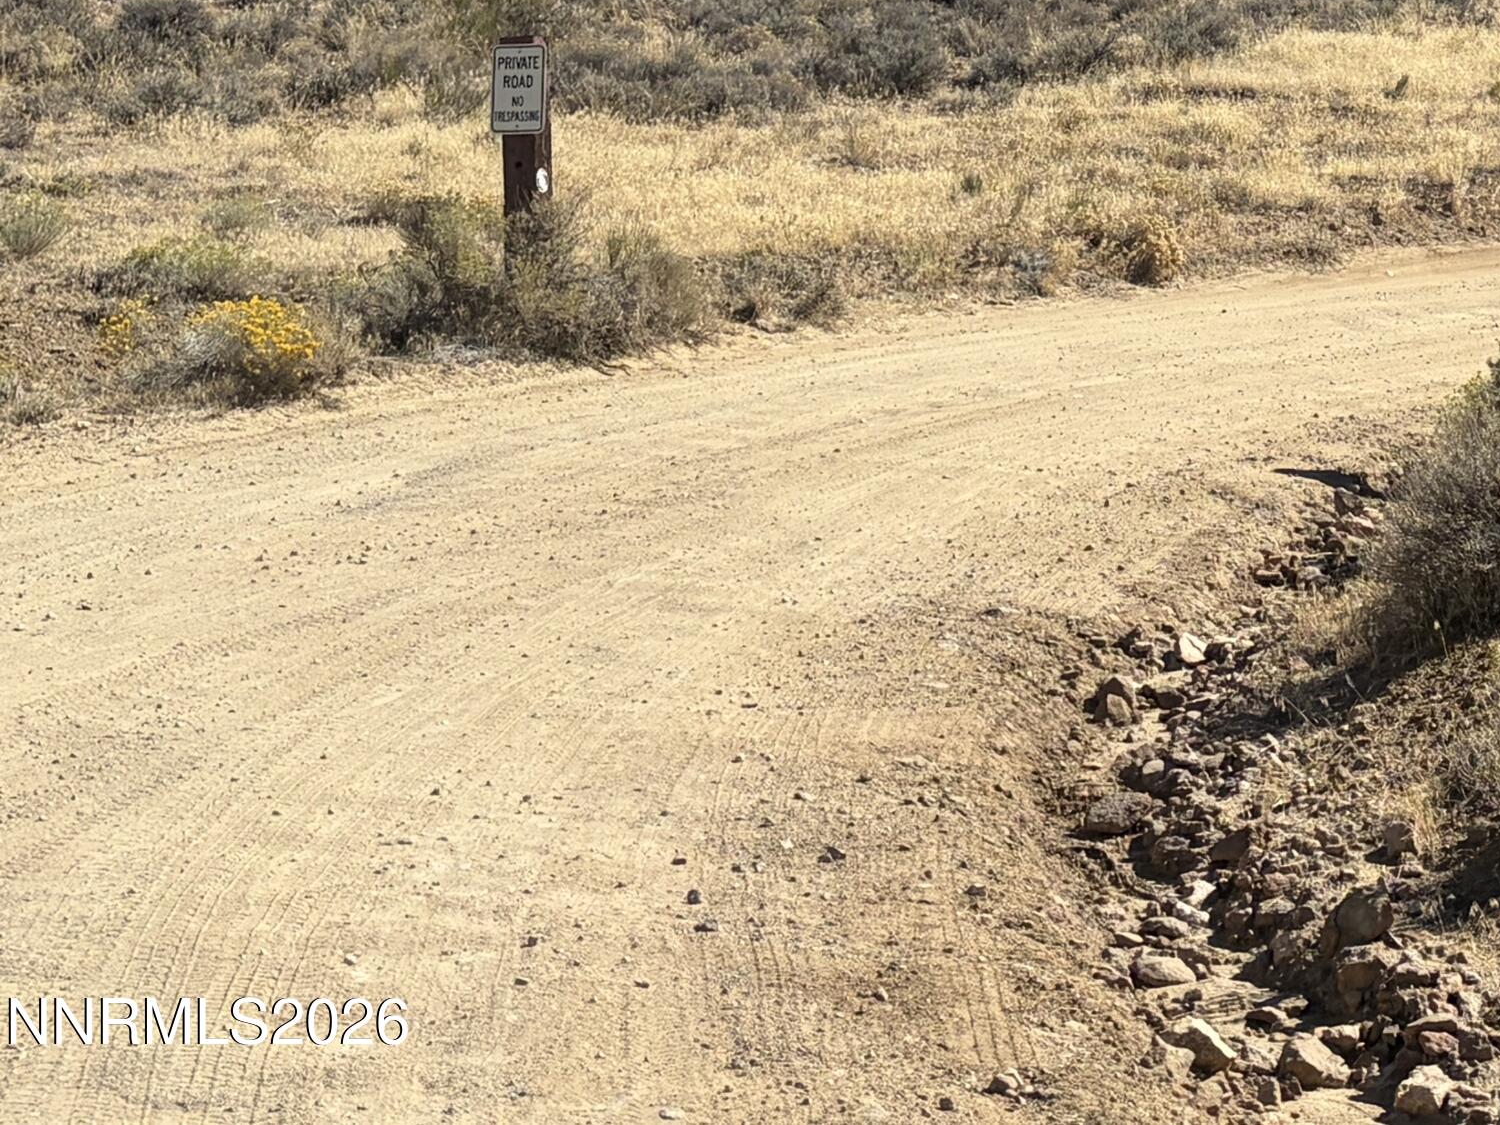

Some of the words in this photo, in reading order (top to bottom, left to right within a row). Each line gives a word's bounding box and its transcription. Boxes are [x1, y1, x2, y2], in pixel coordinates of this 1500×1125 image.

[497, 56, 540, 70] PRIVATE
[503, 75, 533, 88] ROAD
[511, 96, 524, 107] NO
[494, 110, 539, 123] TRESPASSING
